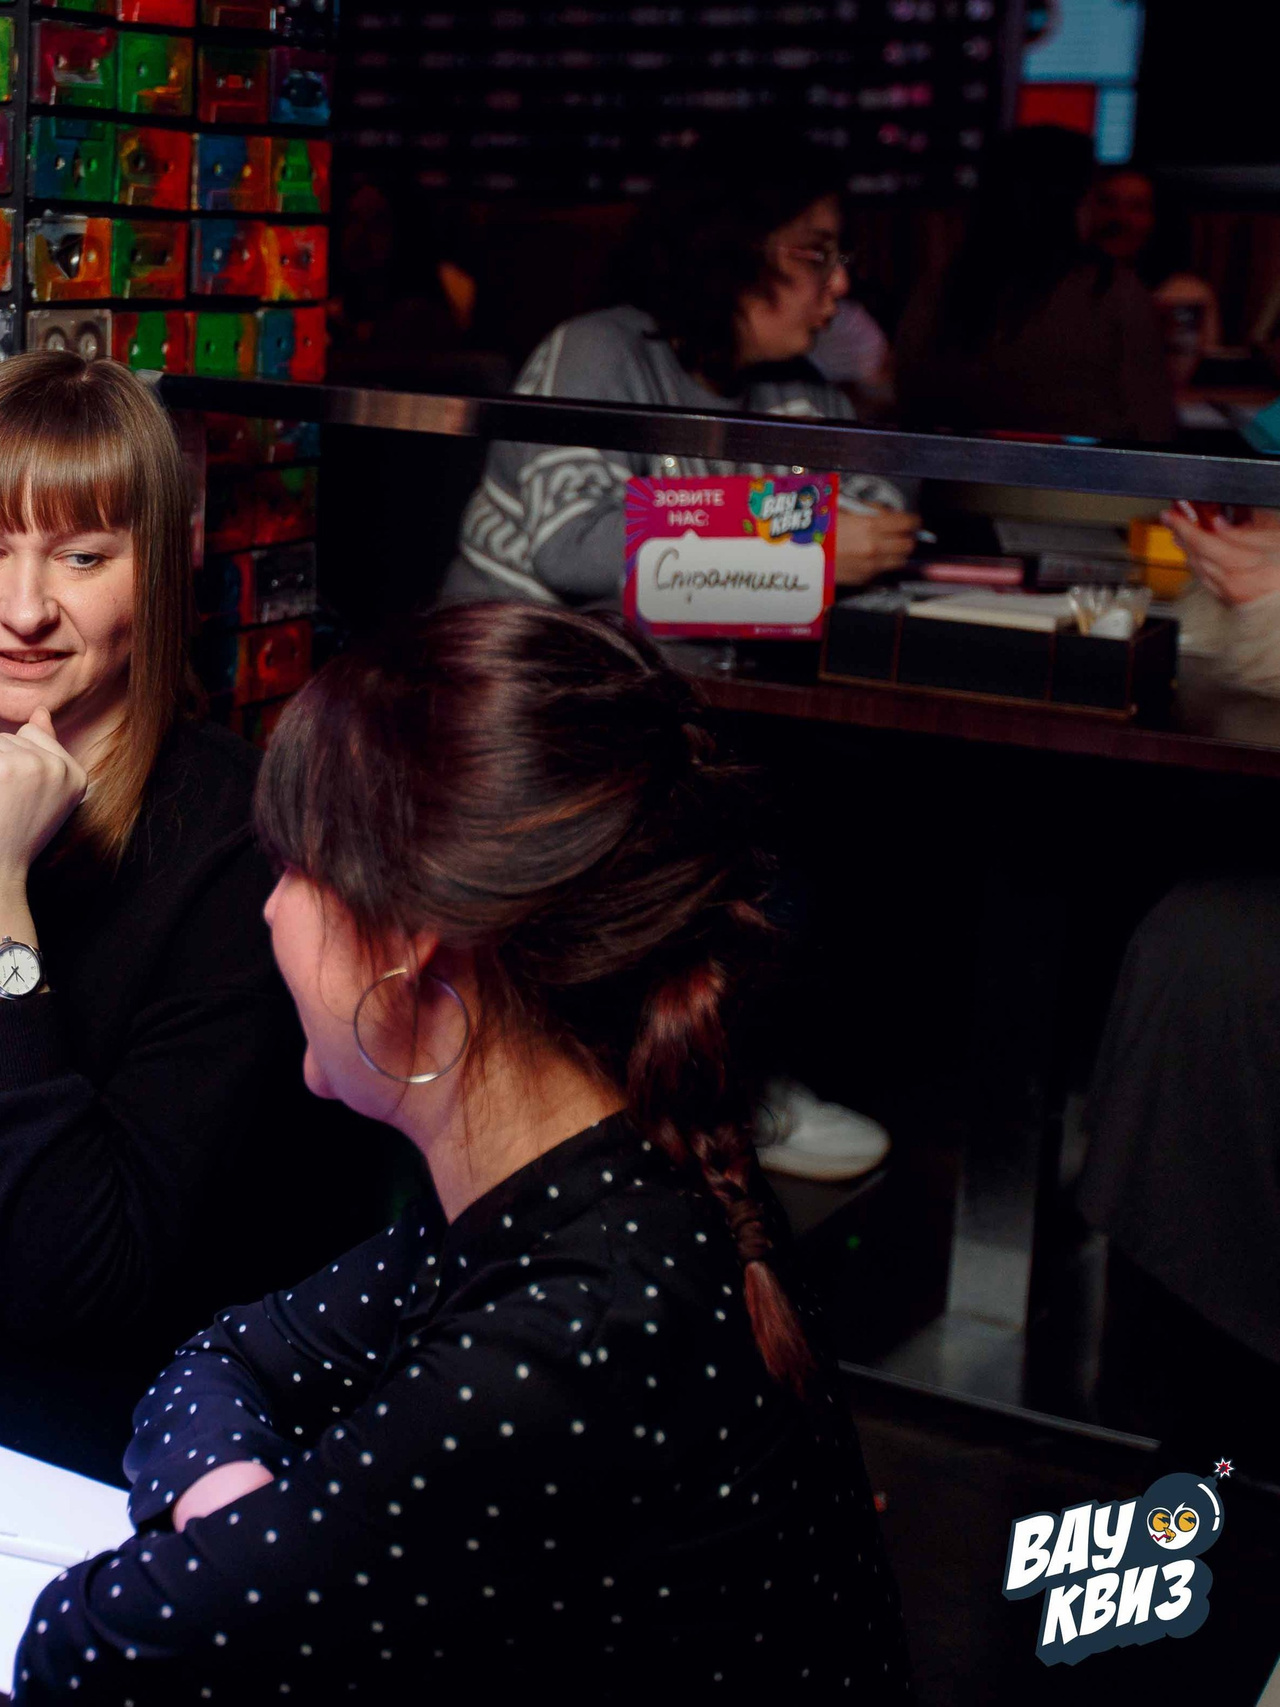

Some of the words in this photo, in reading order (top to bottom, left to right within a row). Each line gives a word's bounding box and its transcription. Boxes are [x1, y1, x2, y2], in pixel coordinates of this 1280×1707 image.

[654, 490, 724, 506] ЗОВИТЕ
[761, 492, 799, 520] ВАУ
[667, 509, 710, 527] НАС:
[770, 507, 813, 536] КВИЗ
